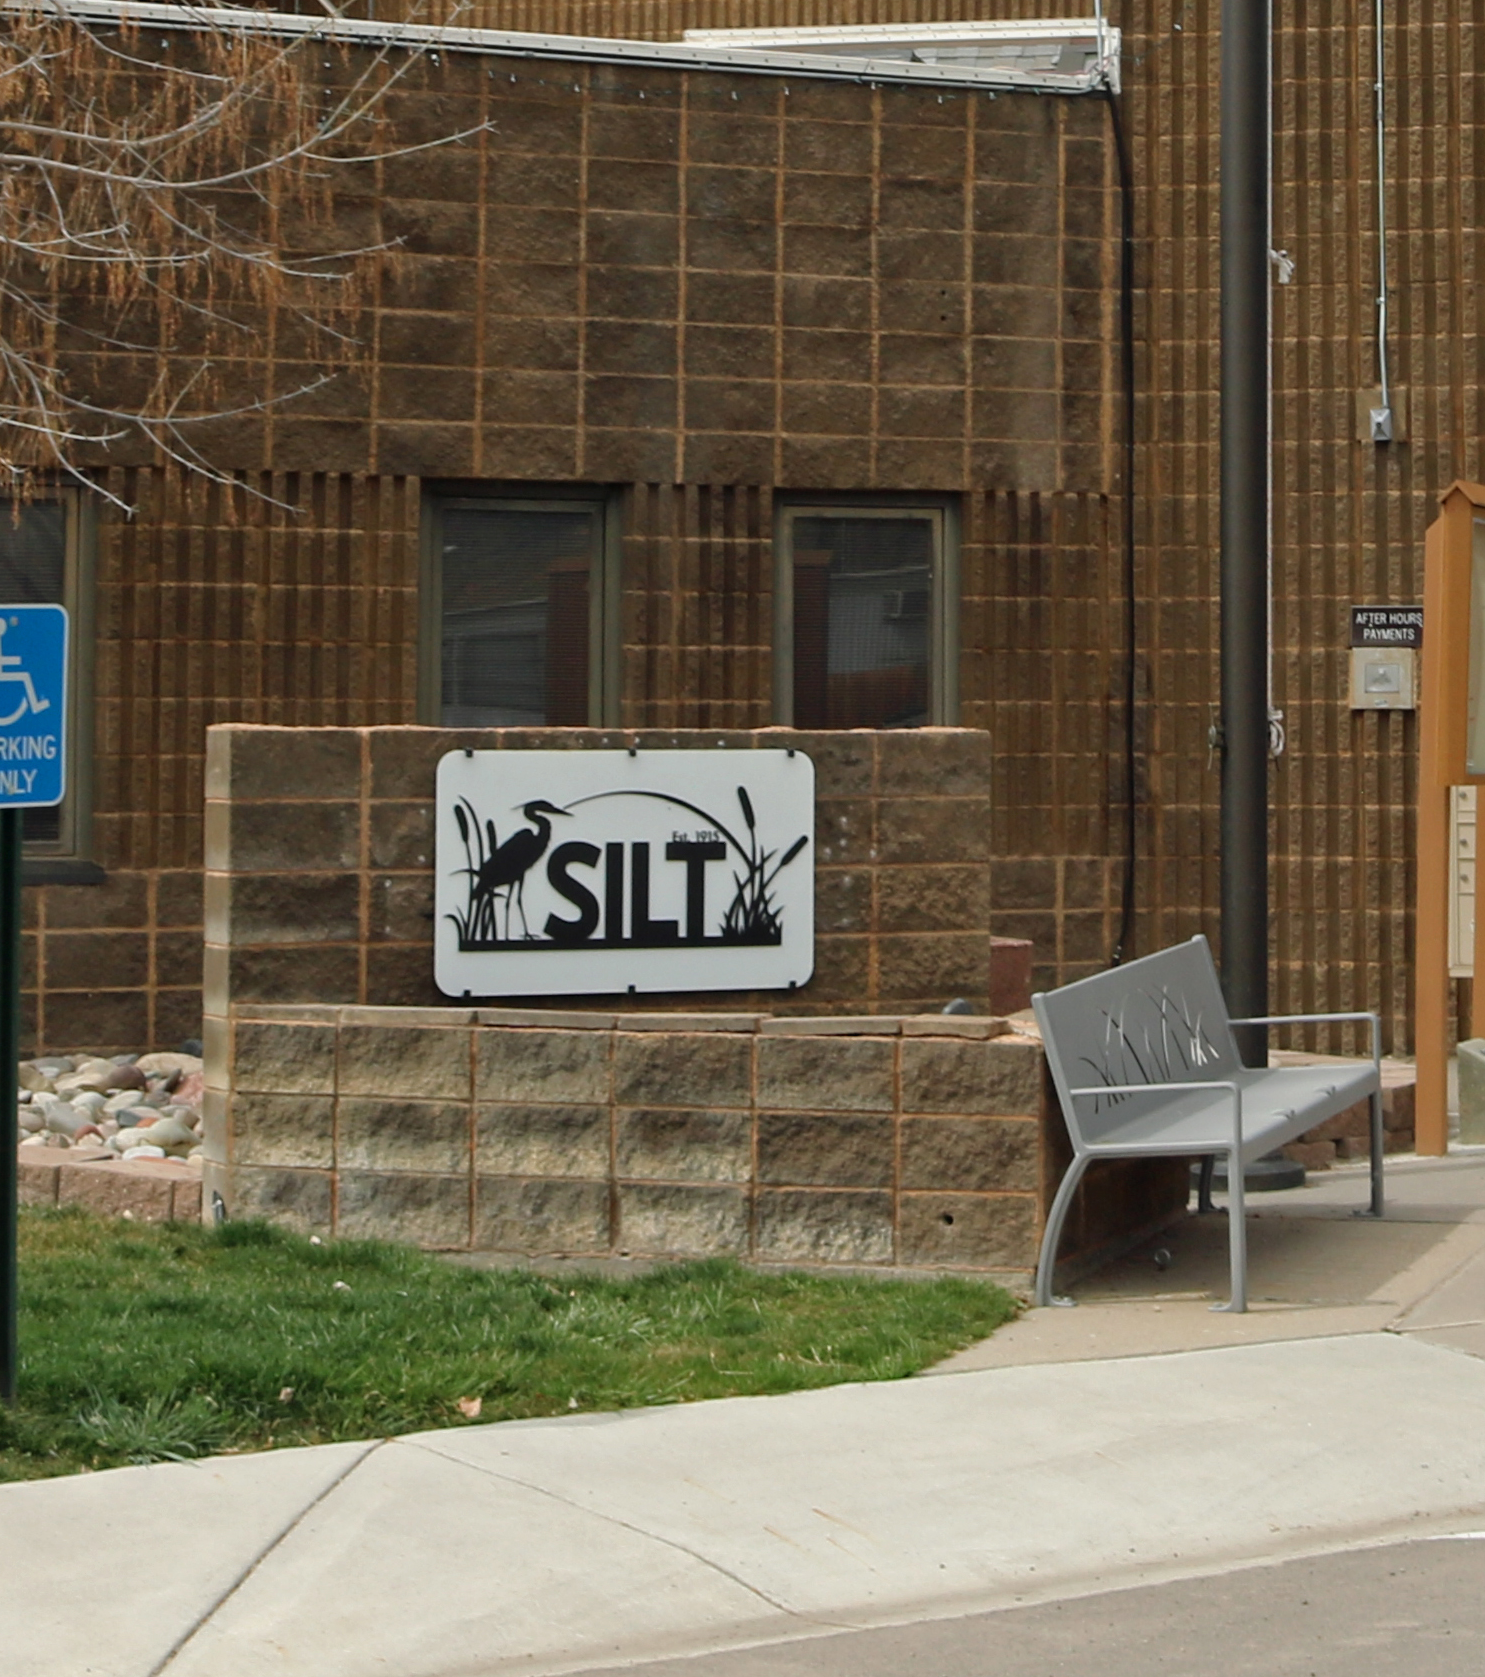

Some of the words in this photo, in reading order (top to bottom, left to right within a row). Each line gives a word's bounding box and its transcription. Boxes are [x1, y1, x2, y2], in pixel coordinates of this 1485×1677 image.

[1355, 612, 1387, 625] AFTER
[1389, 612, 1423, 626] HOURS
[1362, 628, 1416, 641] PAYMENTS
[695, 830, 720, 843] 1915
[543, 841, 726, 941] SILT
